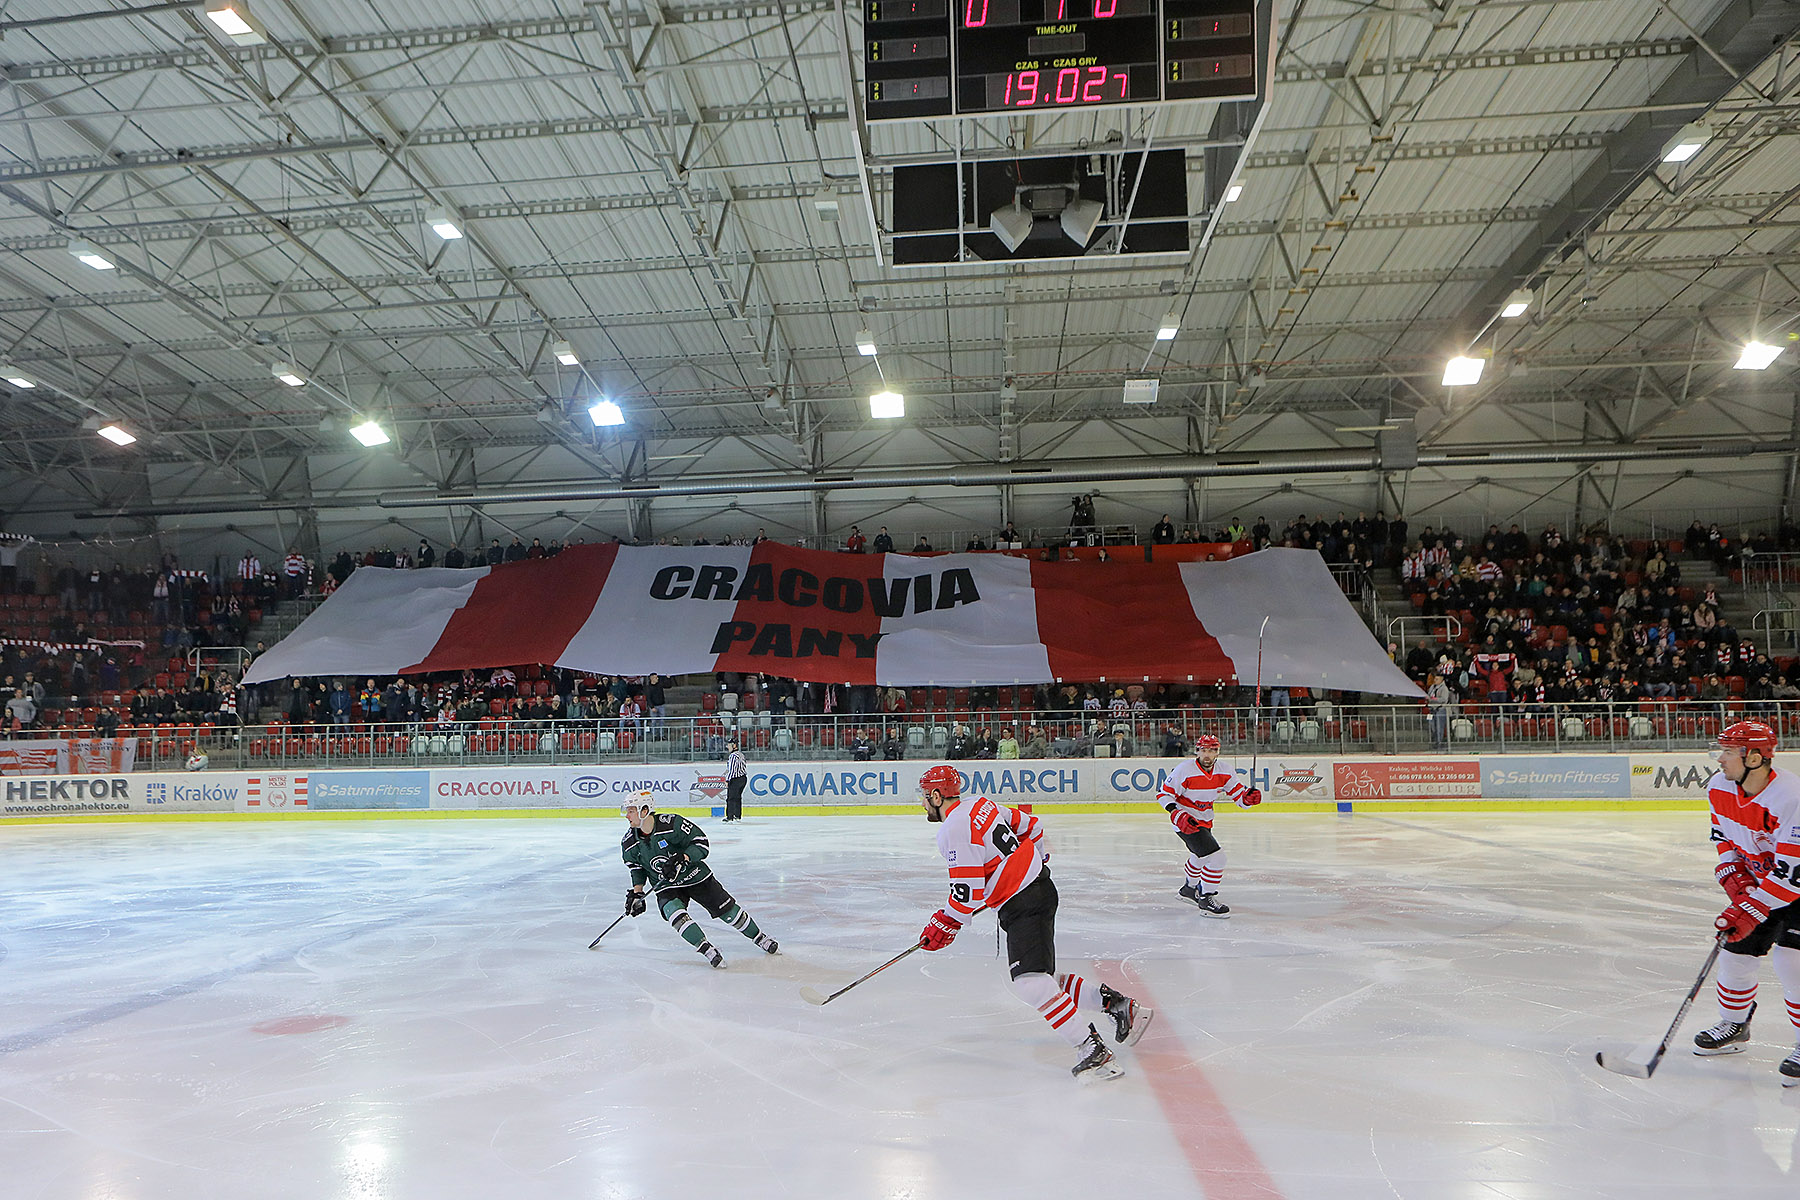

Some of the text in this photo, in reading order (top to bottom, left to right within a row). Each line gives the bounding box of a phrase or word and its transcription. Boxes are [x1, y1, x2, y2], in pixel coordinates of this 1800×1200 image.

[1036, 24, 1078, 35] TIME-OUT
[1015, 57, 1098, 70] CZAS CZAS GRY
[650, 563, 981, 617] CRACOVIA
[710, 621, 890, 658] PANY
[7, 779, 130, 800] HEKTOR
[437, 781, 559, 797] CRACOVIA.PL
[612, 779, 681, 793] CANPACK
[749, 772, 898, 796] COMARCH
[960, 770, 1078, 794] MARCH
[1110, 768, 1270, 792] COMH
[1395, 784, 1476, 795] catering
[174, 783, 238, 801] Kraków
[5, 802, 129, 812] www.ochronahektor.eu
[950, 882, 970, 903] 9
